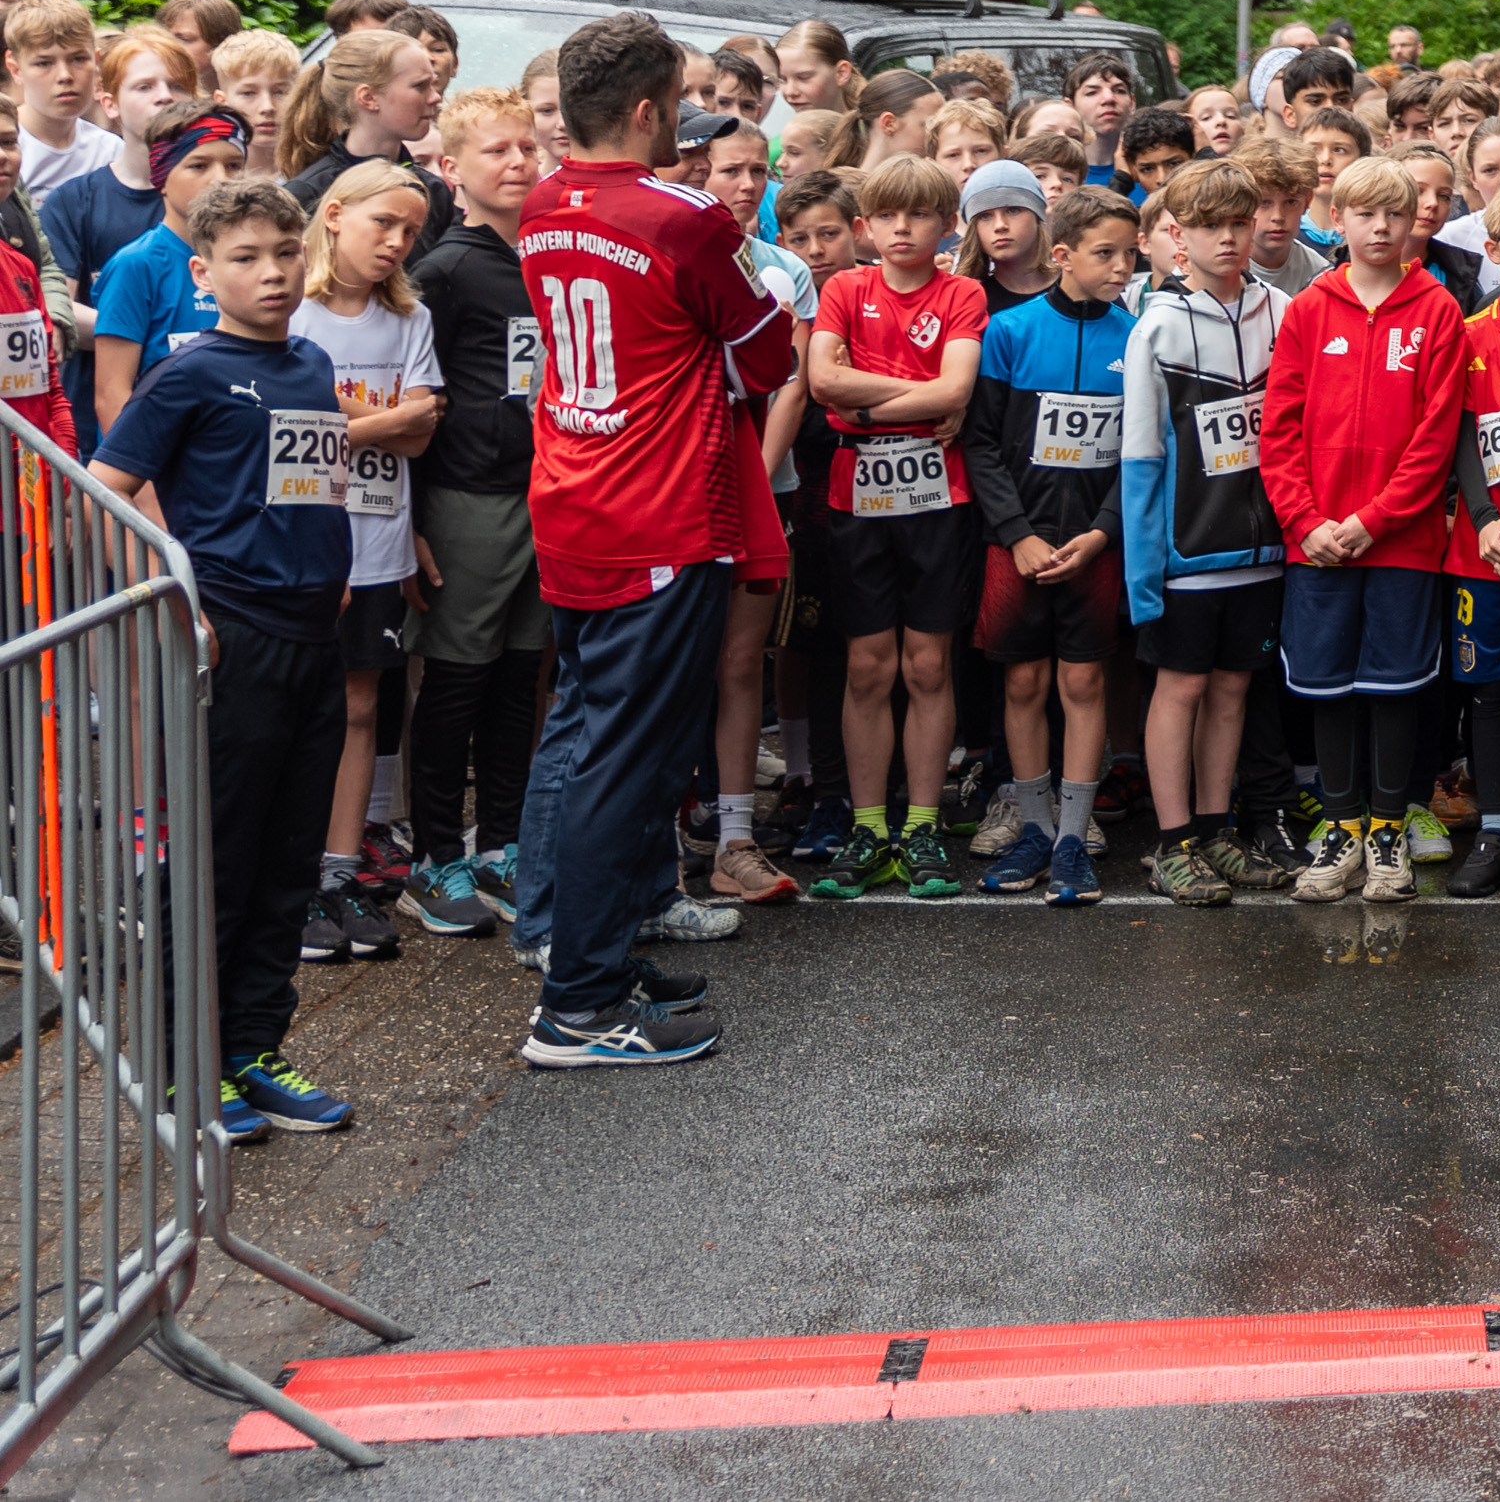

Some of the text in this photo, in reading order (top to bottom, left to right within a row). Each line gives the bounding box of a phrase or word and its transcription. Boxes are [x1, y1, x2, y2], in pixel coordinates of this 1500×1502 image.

[525, 230, 574, 257] BAYERN
[7, 328, 47, 363] 961
[541, 275, 618, 410] 10
[1, 373, 34, 391] EWE
[1047, 399, 1089, 408] Everstener
[1202, 404, 1243, 417] Everstener
[277, 417, 318, 427] Everstener
[1043, 408, 1124, 439] 1971
[1203, 408, 1261, 445] 196
[274, 428, 349, 467] 2206
[1043, 446, 1120, 462] EWE bruns
[1215, 449, 1249, 469] EWE
[313, 468, 330, 476] Noah
[855, 451, 944, 487] 3006
[281, 478, 320, 496] EWE
[879, 486, 916, 495] Jan Felix
[362, 491, 394, 506] bruns
[860, 490, 942, 511] EWE bruns
